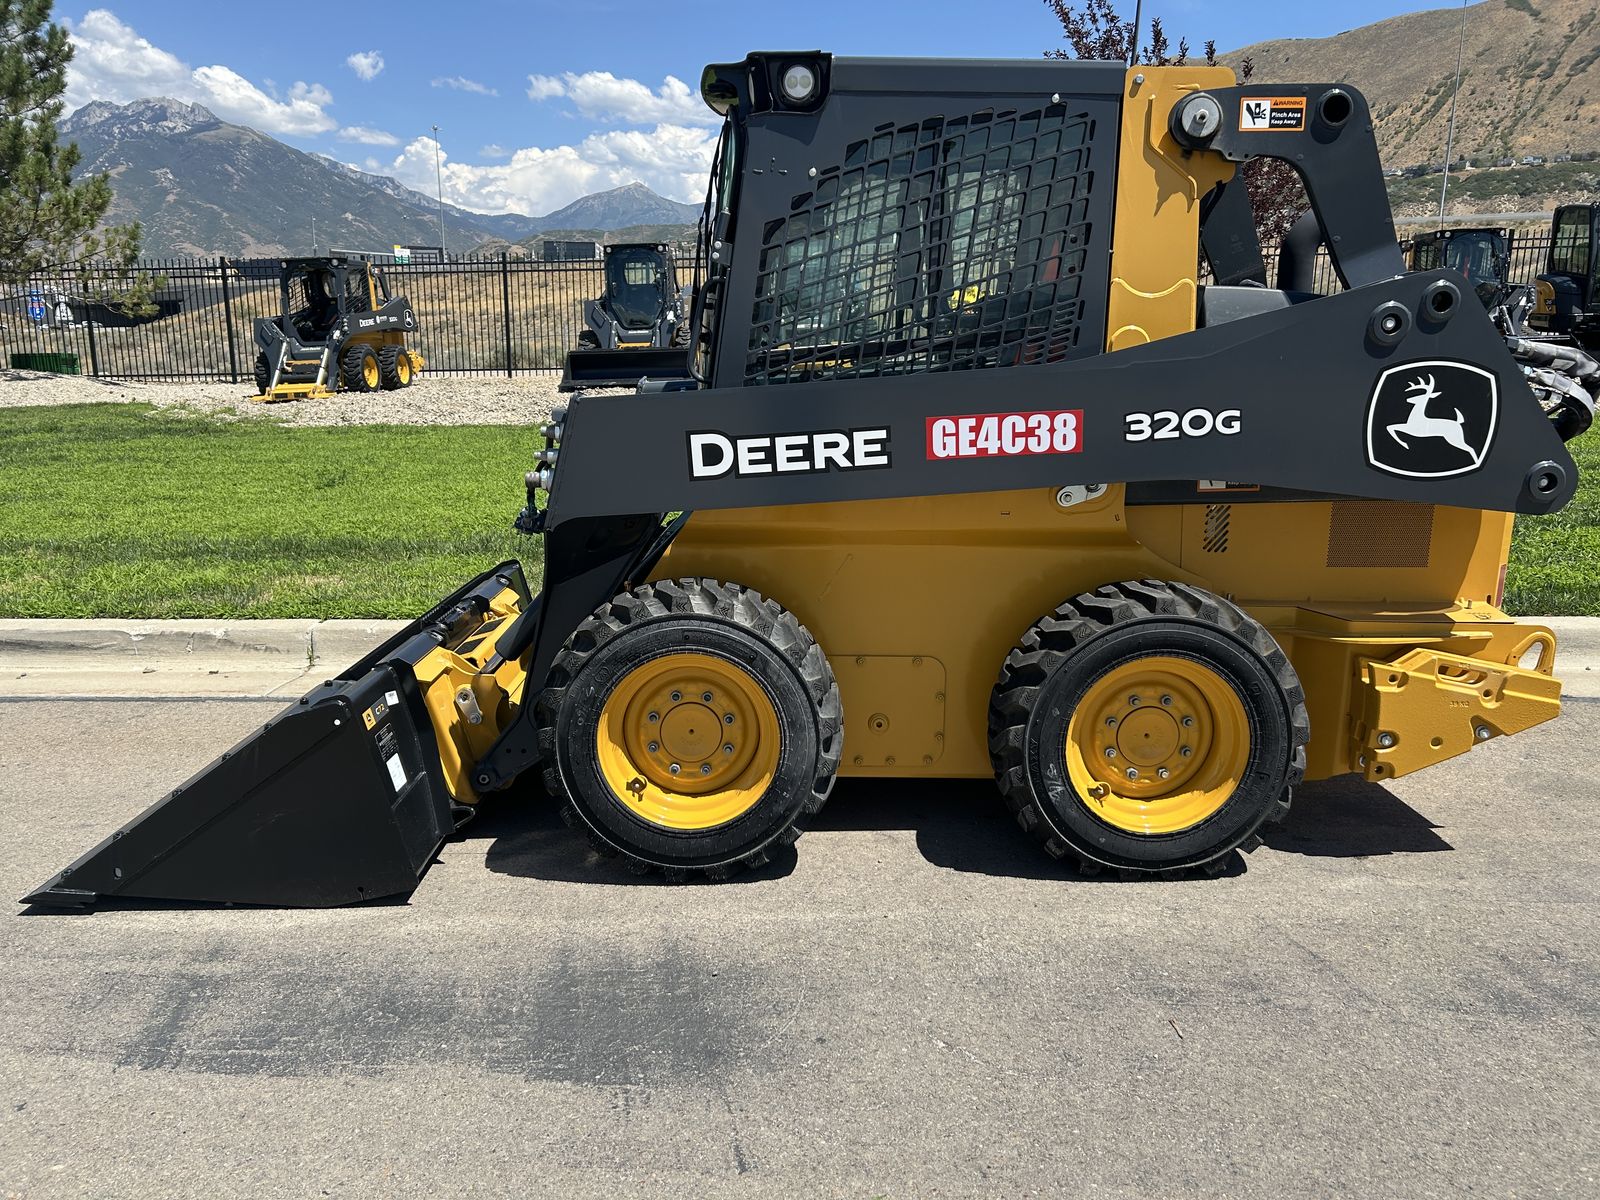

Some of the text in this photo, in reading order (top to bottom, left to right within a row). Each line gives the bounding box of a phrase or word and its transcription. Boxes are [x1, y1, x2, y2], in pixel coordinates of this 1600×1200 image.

[932, 415, 1076, 458] GE4C38
[1125, 409, 1242, 441] 320G
[690, 430, 889, 478] DEERE
